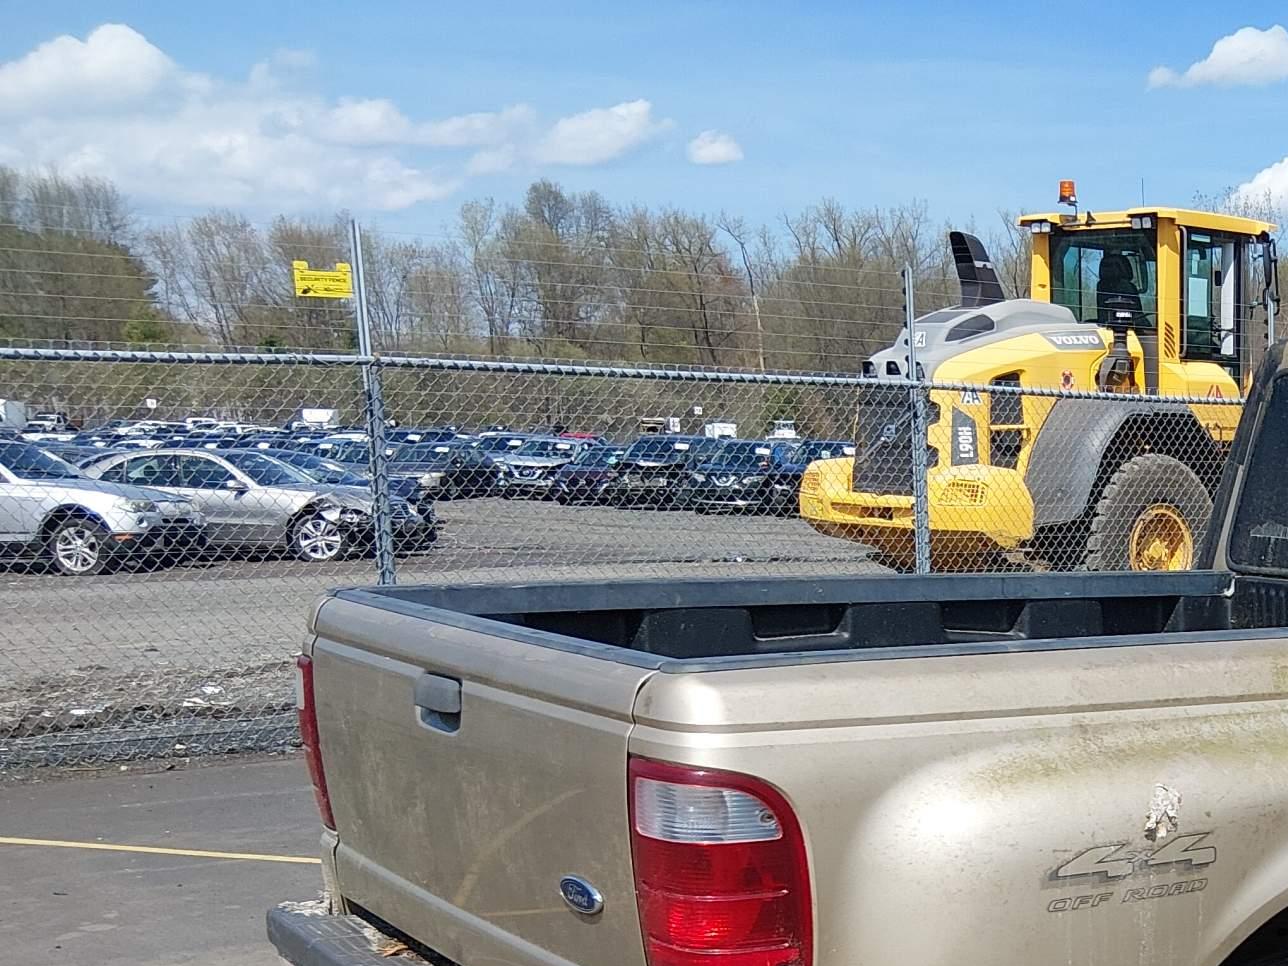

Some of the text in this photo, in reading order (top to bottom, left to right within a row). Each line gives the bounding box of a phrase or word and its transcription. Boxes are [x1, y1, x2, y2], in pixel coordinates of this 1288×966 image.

[1049, 335, 1100, 345] VOLVO
[958, 426, 974, 458] L90H
[1047, 878, 1209, 913] OFF ROAD
